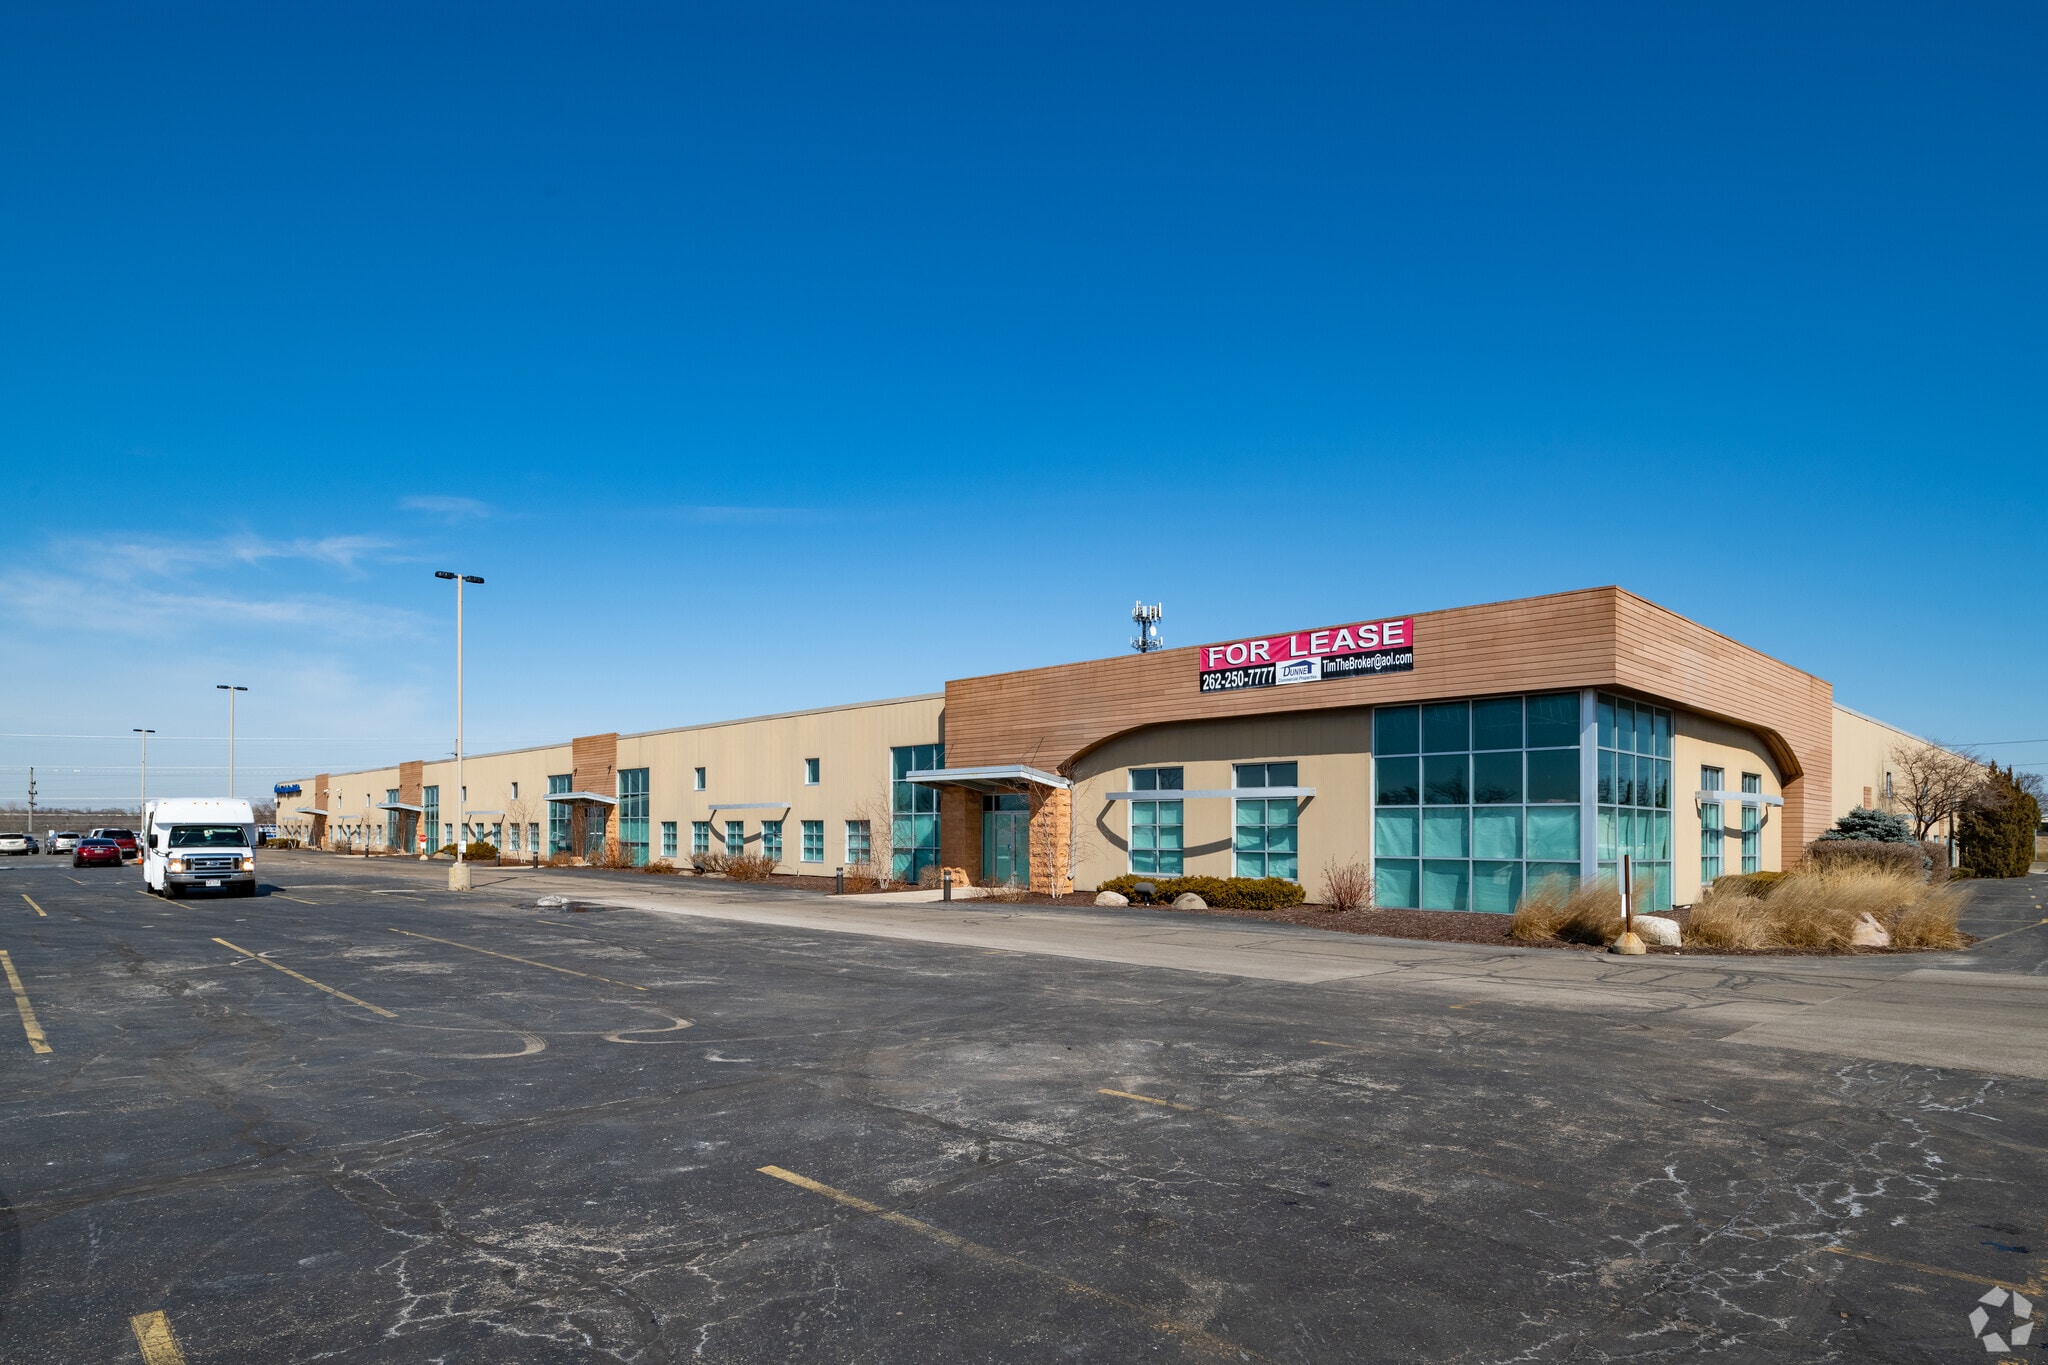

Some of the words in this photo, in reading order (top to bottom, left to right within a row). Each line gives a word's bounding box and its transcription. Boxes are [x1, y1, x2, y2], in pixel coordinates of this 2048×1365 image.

[1208, 640, 1271, 668] FOR
[1290, 620, 1405, 657] LEASE
[1322, 652, 1413, 673] TimTheBroker@aol.com
[1203, 666, 1275, 691] 262-250-7777
